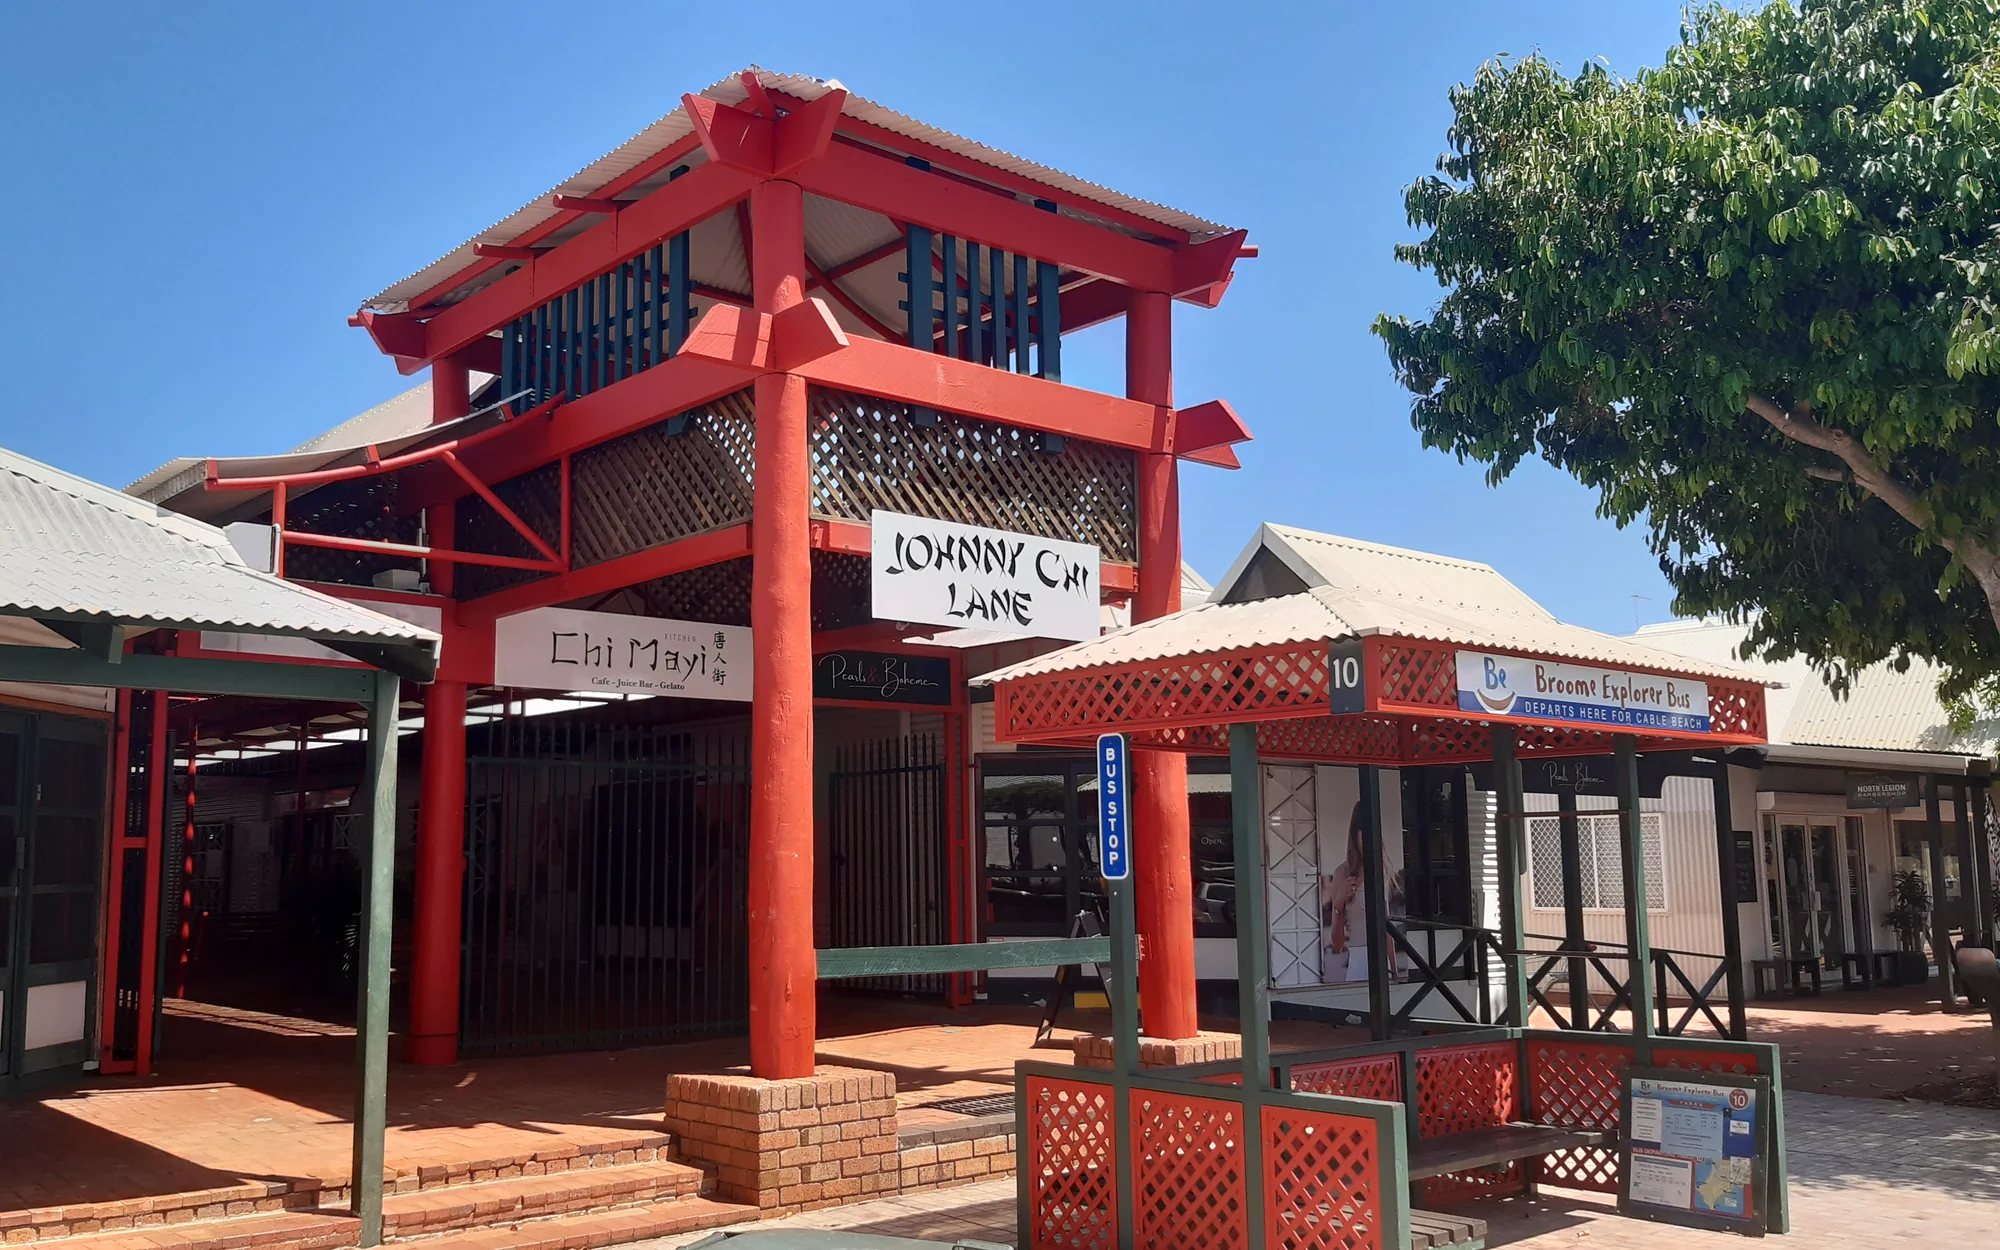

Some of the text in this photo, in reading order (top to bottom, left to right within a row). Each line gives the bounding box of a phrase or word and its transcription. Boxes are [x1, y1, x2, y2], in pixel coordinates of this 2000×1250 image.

[885, 531, 1090, 603] JOHNNY CHI
[945, 582, 1034, 627] LANE
[664, 633, 697, 643] KITCHEN
[551, 631, 707, 683] Chi Mayi
[711, 631, 727, 686] 唐人街
[1332, 656, 1359, 689] 10
[1483, 656, 1507, 690] Be
[591, 676, 610, 686] Cafe
[616, 678, 638, 689] Juice
[639, 680, 654, 688] Bar
[659, 681, 685, 690] Gelato
[818, 653, 867, 689] Pearls
[881, 657, 939, 698] Boheme
[1535, 664, 1691, 709] Broome Explorer Bus
[1524, 701, 1702, 730] DEPARTS HERE FOR CABLE BEACH
[1857, 783, 1906, 793] NORTH LEGION
[1105, 747, 1119, 866] BUS STOP
[1656, 1083, 1681, 1092] Broome
[1683, 1085, 1712, 1096] Explorer
[1713, 1089, 1725, 1097] Bus
[1732, 1094, 1746, 1107] 10
